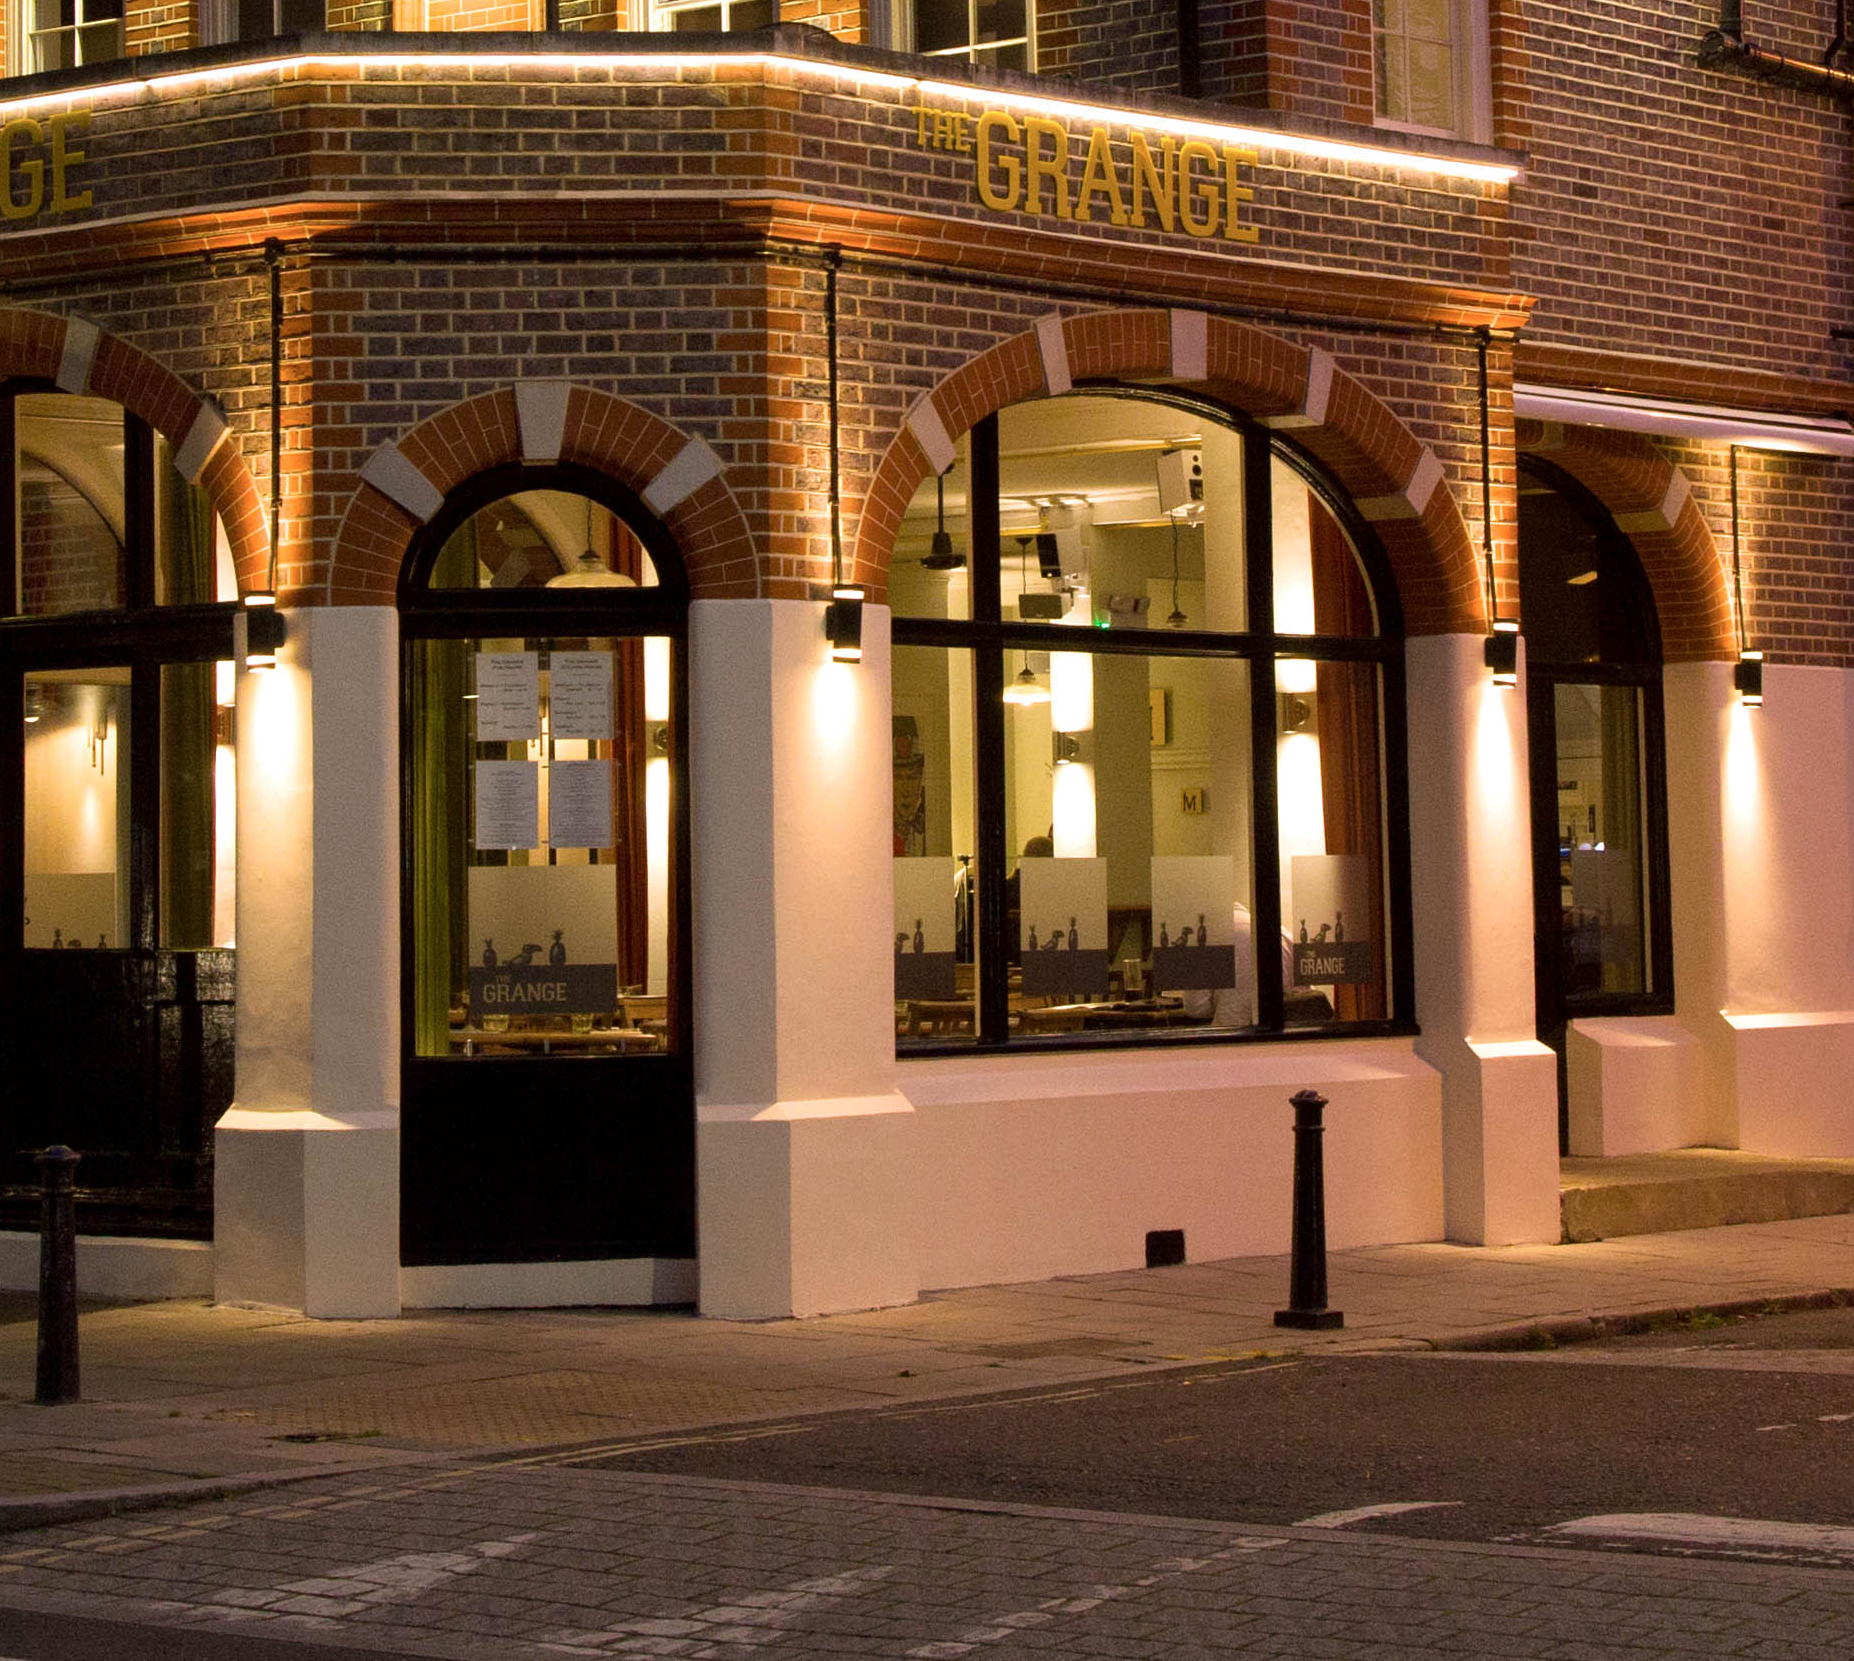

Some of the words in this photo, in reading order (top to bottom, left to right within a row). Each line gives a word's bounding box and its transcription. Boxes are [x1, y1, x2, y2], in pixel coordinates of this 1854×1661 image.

[912, 106, 972, 152] THE
[976, 110, 1260, 243] GRANGE
[1300, 957, 1345, 975] GRANGE
[482, 982, 567, 1002] GRANGE
